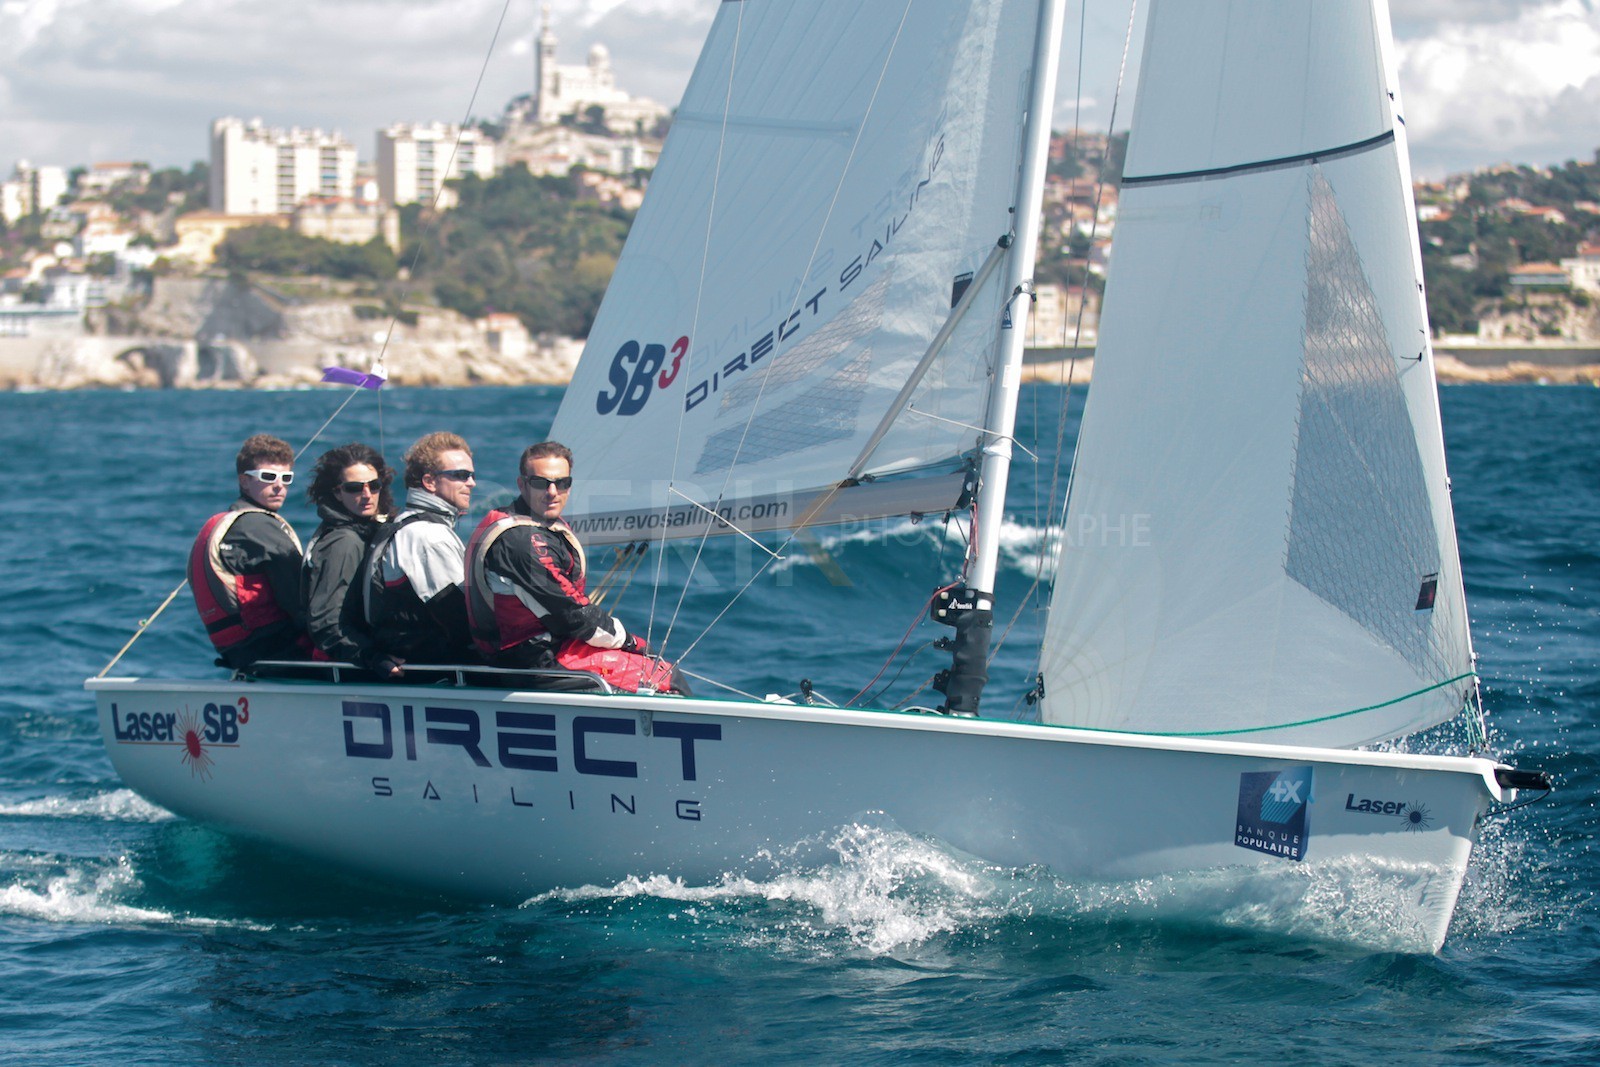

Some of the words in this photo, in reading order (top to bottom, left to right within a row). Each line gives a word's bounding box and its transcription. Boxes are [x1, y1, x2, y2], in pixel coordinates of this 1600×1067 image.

[685, 286, 828, 413] DIRECT
[839, 132, 946, 293] SAILING
[595, 335, 690, 417] SB3
[567, 499, 789, 534] www.evosailing.com
[111, 702, 177, 742] Laser
[202, 696, 250, 743] SB3
[341, 701, 722, 781] DIRECT
[371, 776, 701, 822] SAILING
[1345, 793, 1406, 816] Laser
[1236, 834, 1299, 857] POPULAIRE
[1238, 824, 1300, 845] BANQUE
